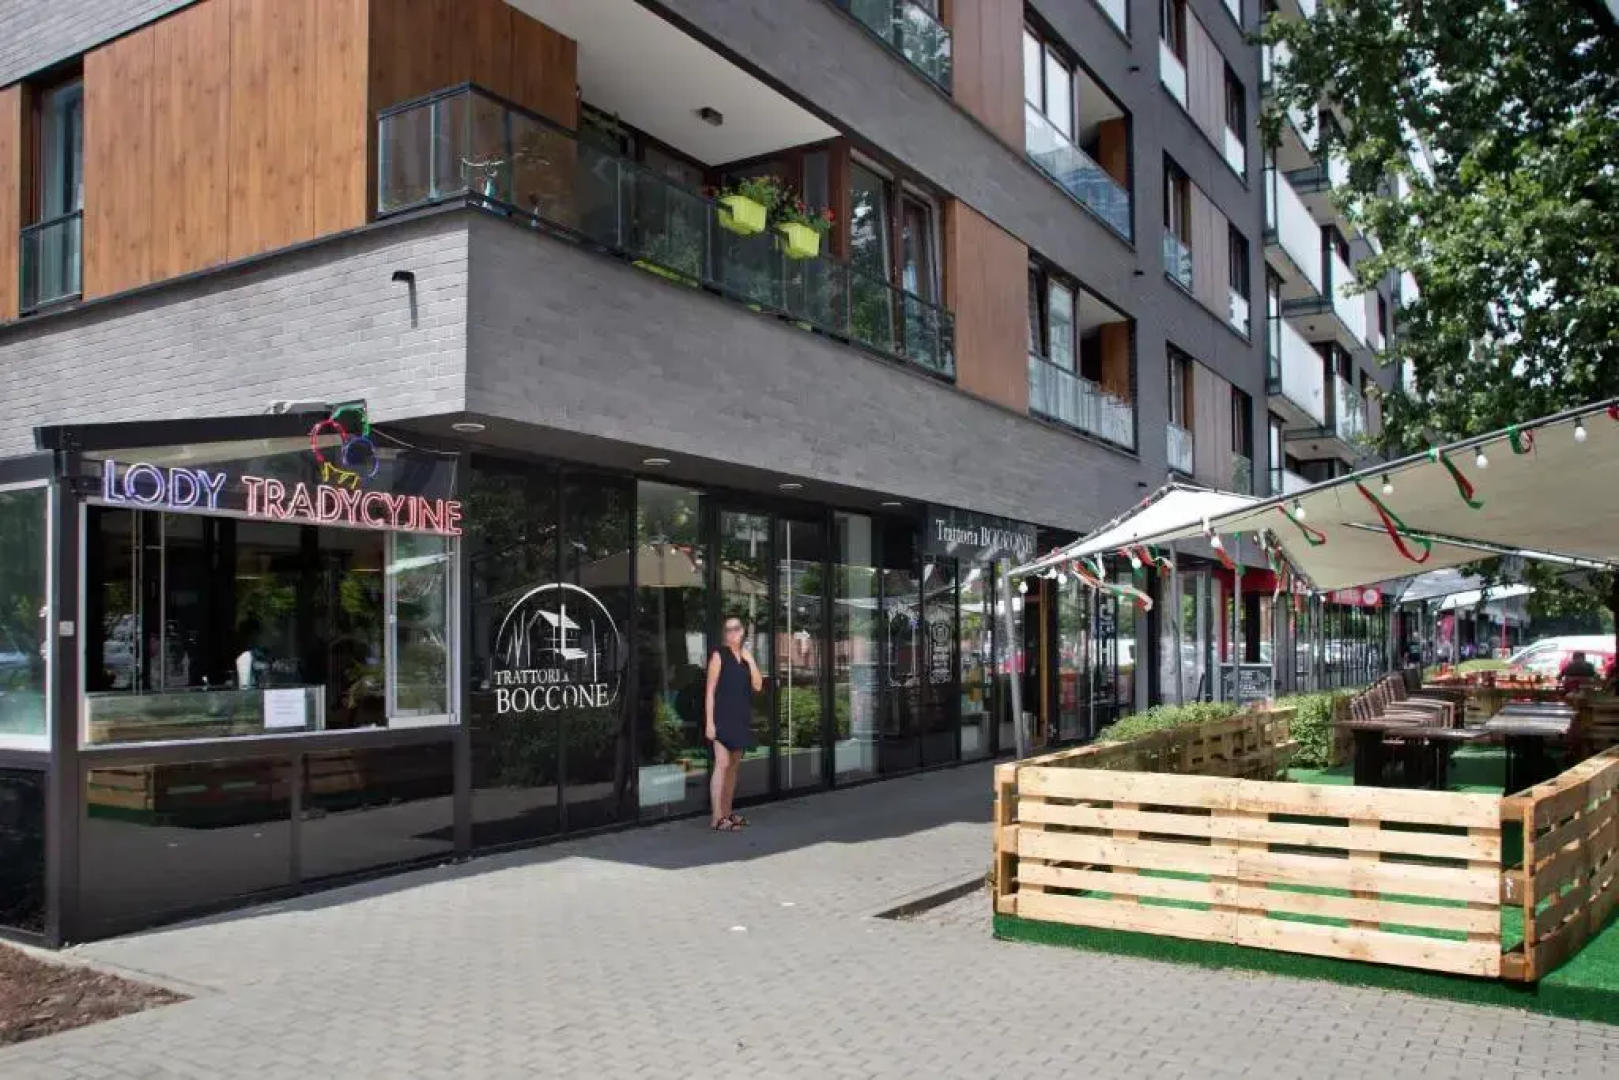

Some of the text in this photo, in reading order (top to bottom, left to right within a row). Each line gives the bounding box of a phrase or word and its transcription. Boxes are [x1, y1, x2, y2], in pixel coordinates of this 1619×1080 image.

[104, 459, 462, 535] LODY TRADYCYJNE
[494, 683, 609, 713] BOCCONE
